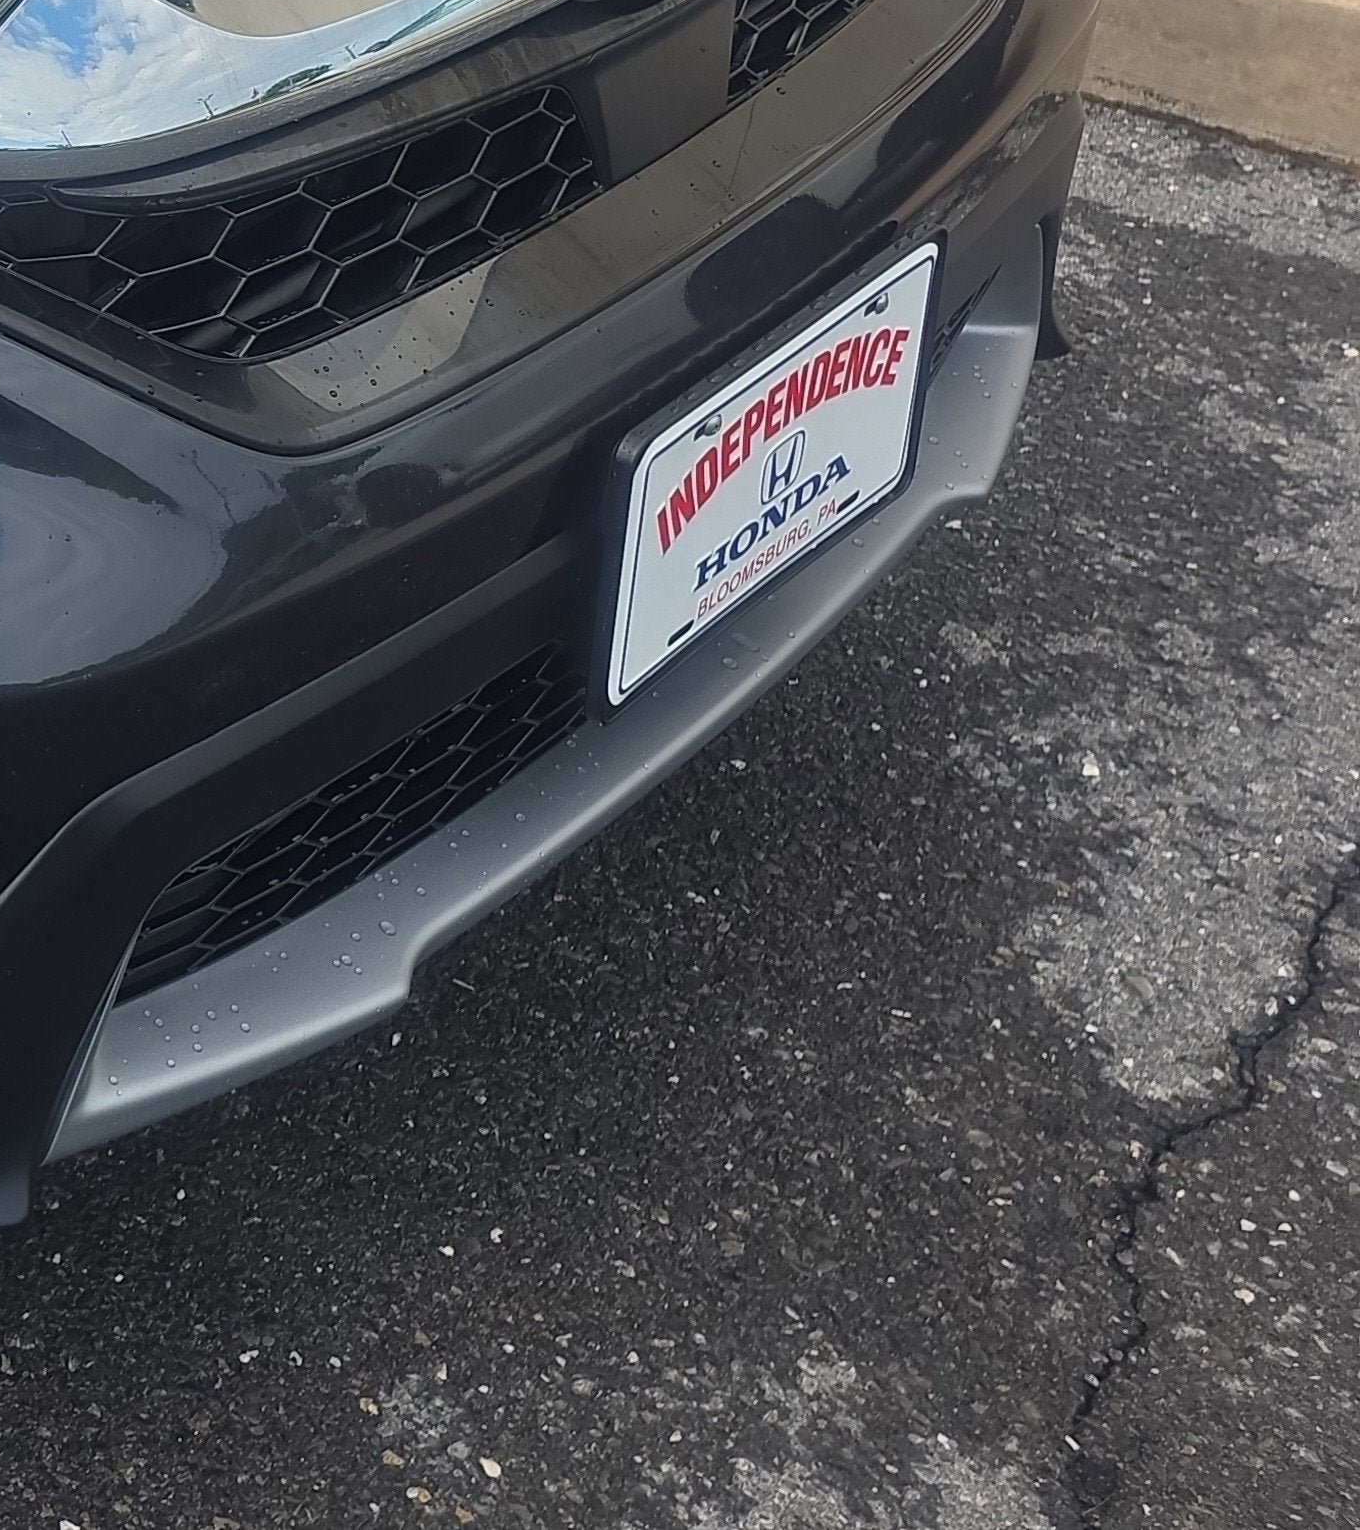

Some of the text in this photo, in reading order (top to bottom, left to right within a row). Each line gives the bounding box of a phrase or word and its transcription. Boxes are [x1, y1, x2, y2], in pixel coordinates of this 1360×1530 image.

[655, 327, 911, 556] INDEPENDENCE
[693, 455, 851, 592] HONDA
[697, 498, 837, 619] BLOOMSBURG, PA
